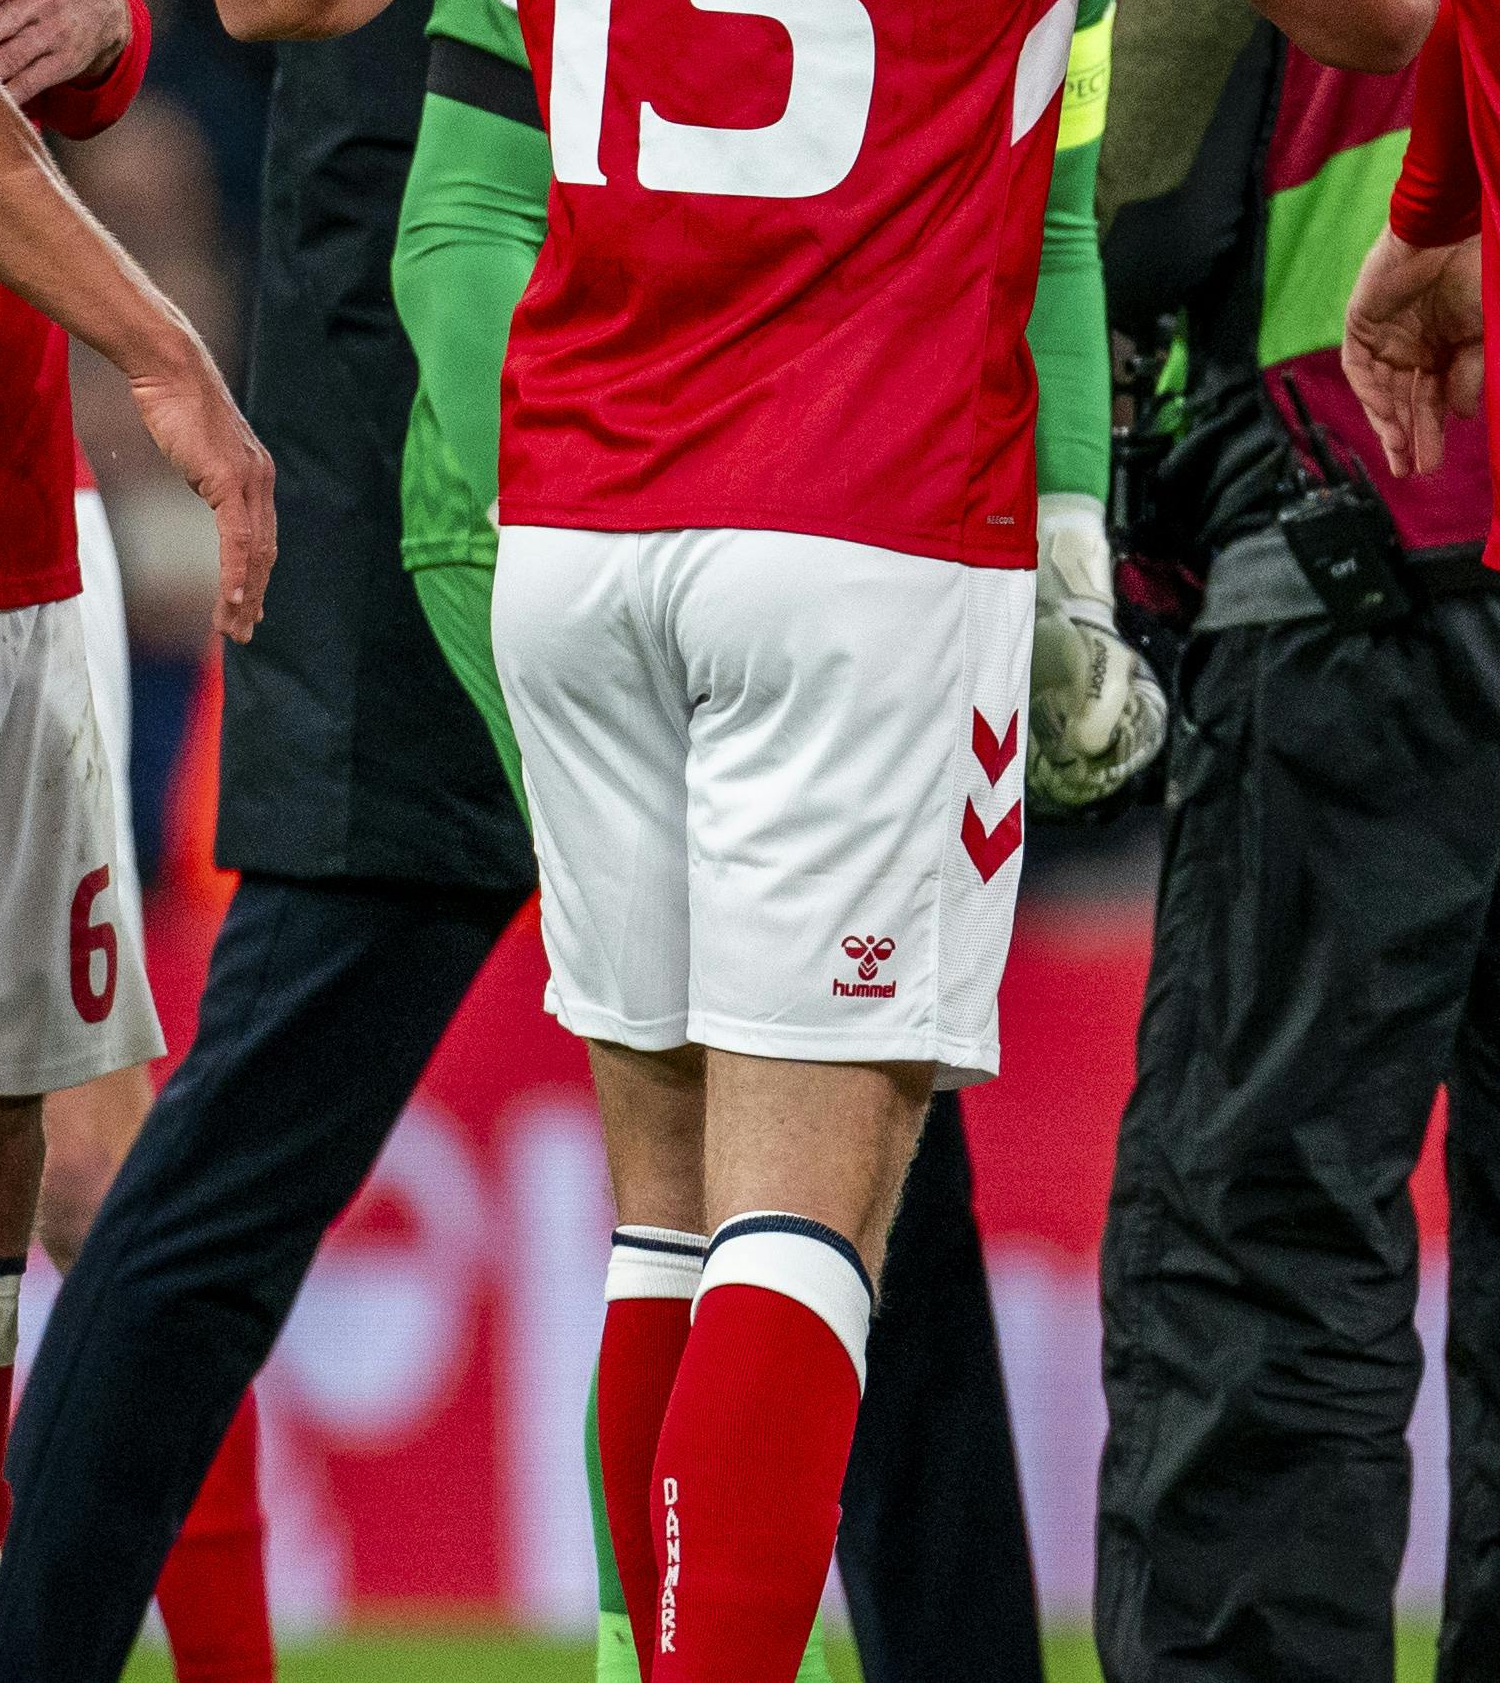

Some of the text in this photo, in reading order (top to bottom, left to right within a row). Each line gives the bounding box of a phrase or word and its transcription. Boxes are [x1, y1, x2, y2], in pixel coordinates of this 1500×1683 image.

[70, 864, 117, 1024] 6
[833, 978, 896, 998] hummel
[661, 1477, 680, 1654] DANMARK
